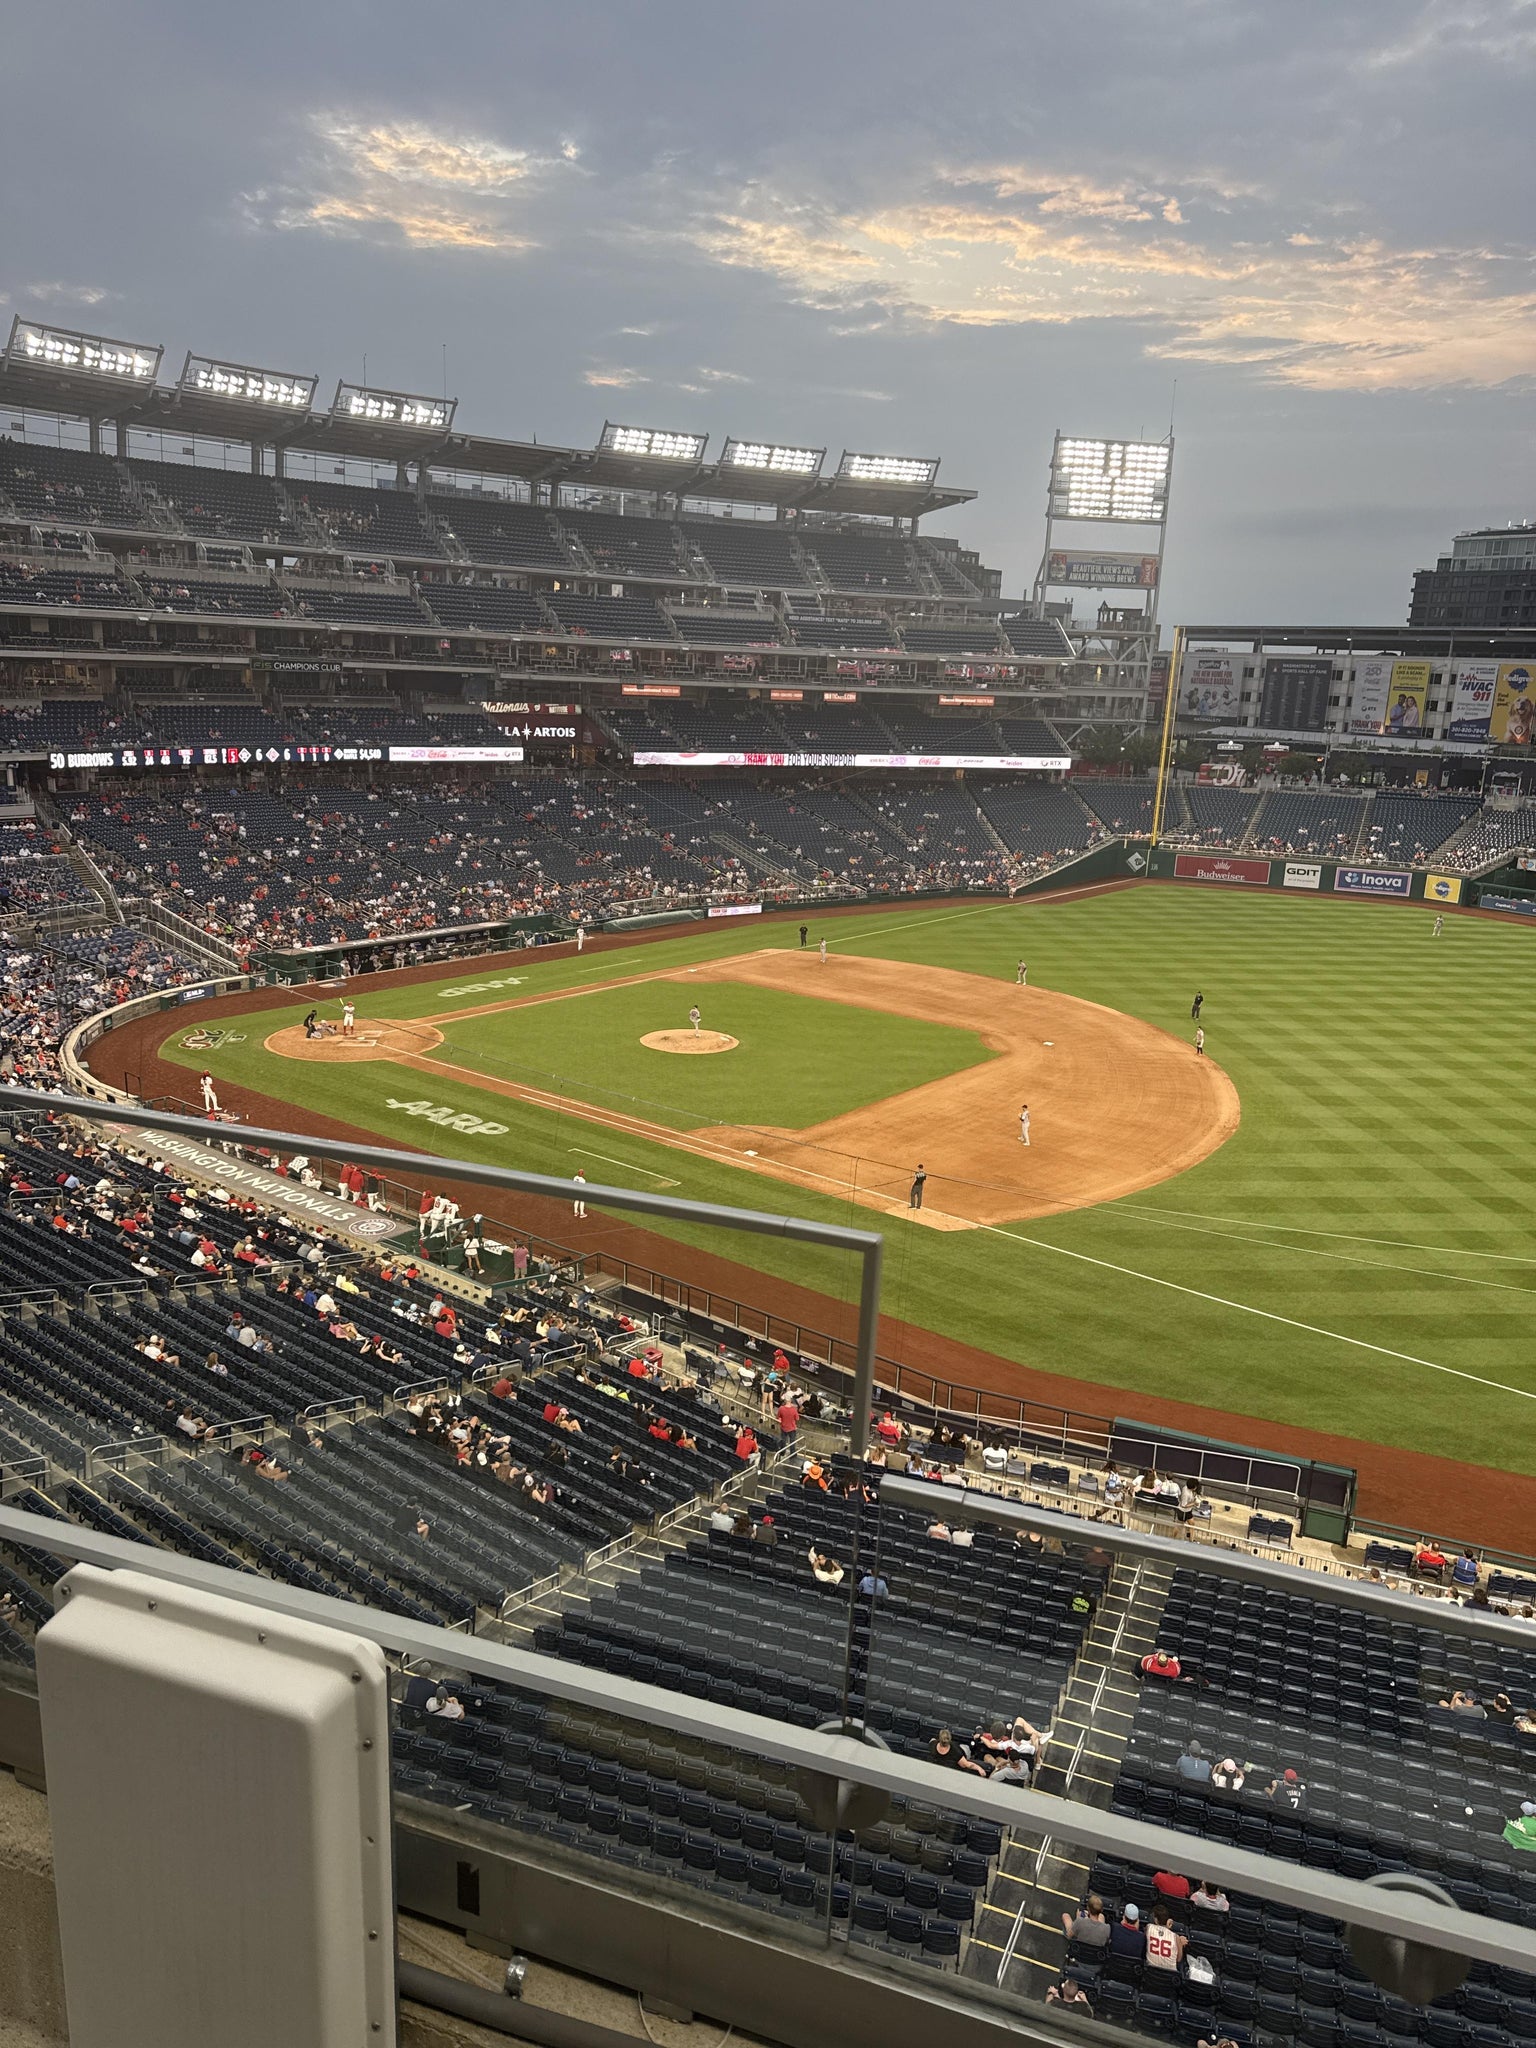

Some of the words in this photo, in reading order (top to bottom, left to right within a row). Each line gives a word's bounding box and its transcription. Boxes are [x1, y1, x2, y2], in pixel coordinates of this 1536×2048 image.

[1073, 564, 1101, 573] BEAUTIFUL
[1103, 565, 1121, 574] VIEWS
[1122, 566, 1134, 574] AND
[1069, 572, 1089, 581] AWARD
[1091, 573, 1115, 582] WINNING
[274, 662, 320, 671] CHAMPIONS
[320, 664, 341, 672] CLUB
[1461, 681, 1494, 692] HVAC
[1472, 691, 1492, 702] 911
[480, 702, 530, 714] Nationals
[534, 727, 576, 738] ARTOIS
[50, 752, 65, 769] 50
[68, 752, 114, 768] BURROWS
[256, 748, 262, 761] 6
[284, 748, 290, 760] 6
[744, 752, 768, 766] THANK
[770, 753, 784, 766] YOU
[788, 754, 800, 766] FOR
[804, 754, 822, 766] YOUR
[824, 754, 856, 767] SUPPORT
[1197, 868, 1246, 881] Budweiser
[1286, 868, 1320, 876] GDIT
[1362, 873, 1402, 887] Inova
[386, 1098, 510, 1135] AARP
[137, 1130, 250, 1182] WASHINGTON
[246, 1175, 356, 1222] NATIONALS
[1290, 1798, 1298, 1808] 7
[1150, 1936, 1172, 1958] 26
